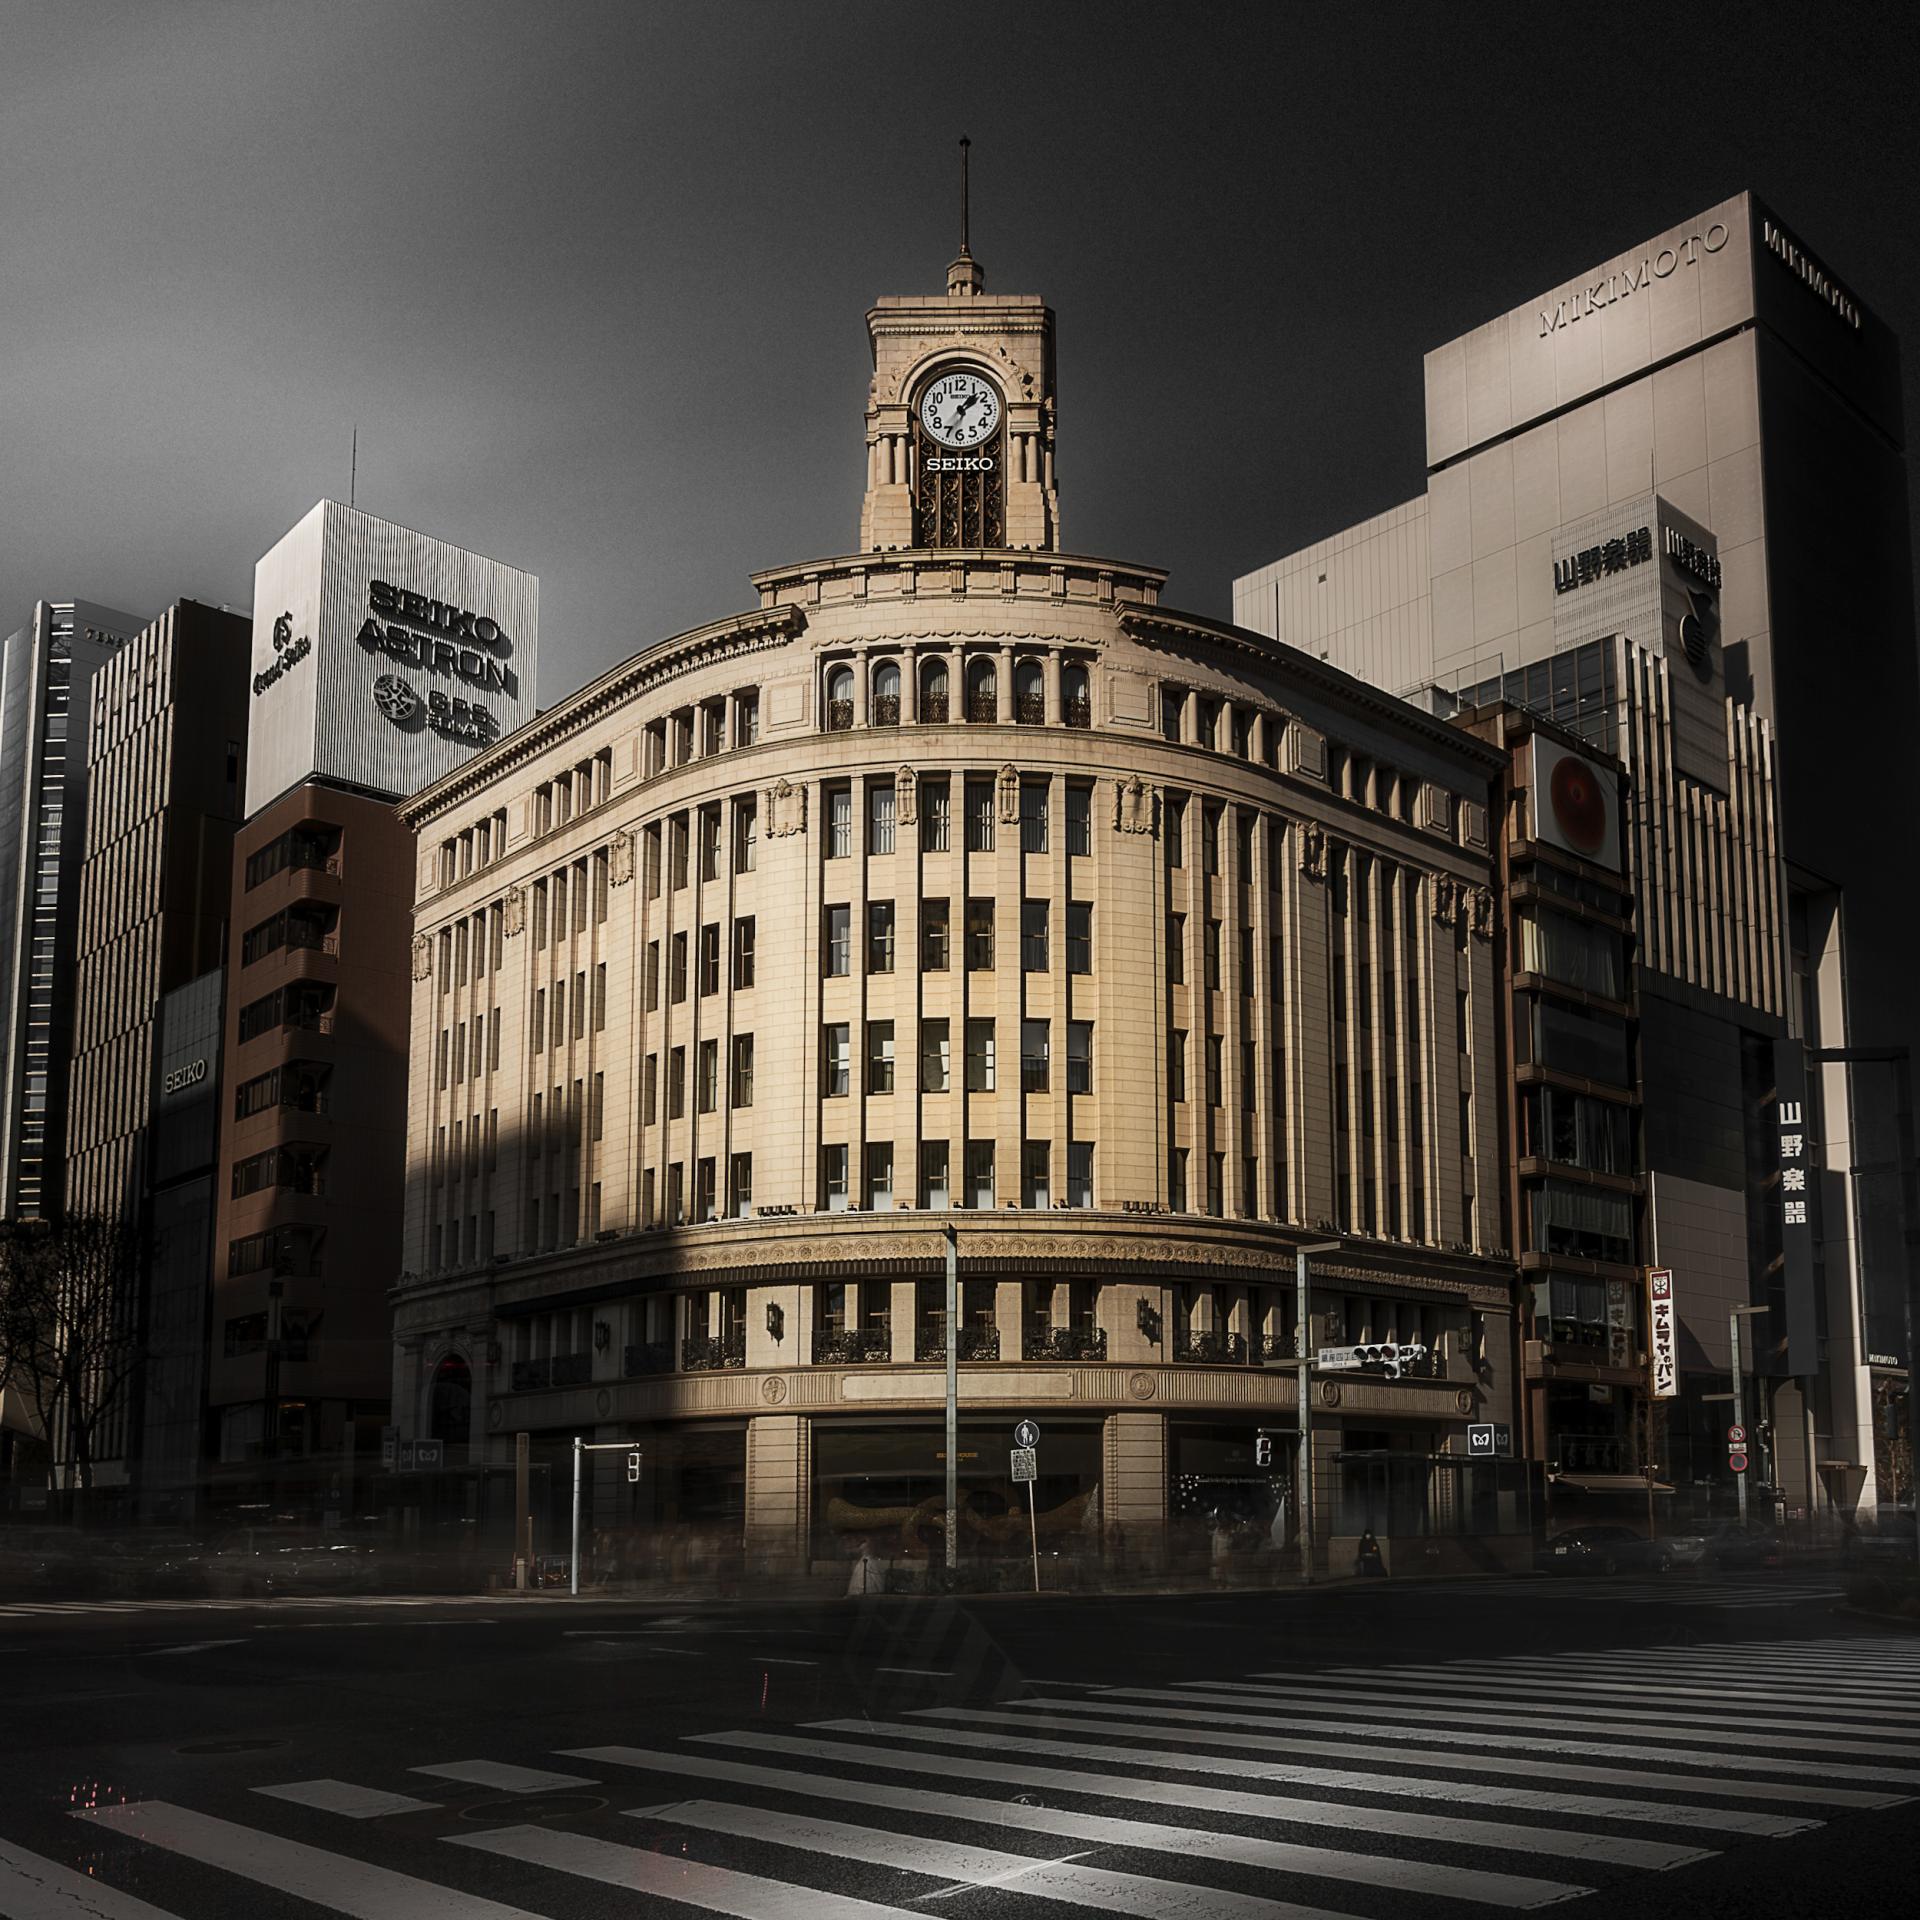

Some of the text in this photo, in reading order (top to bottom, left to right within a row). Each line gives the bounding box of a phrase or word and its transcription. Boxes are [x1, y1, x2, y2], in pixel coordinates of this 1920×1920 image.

[1763, 218, 1861, 330] MIKIMOTO
[1540, 223, 1729, 338] MIKIMOTO
[944, 382, 952, 394] 11
[955, 379, 966, 391] 12
[972, 382, 975, 394] 1
[933, 392, 943, 404] 10
[979, 391, 988, 403] 2
[928, 405, 937, 416] 9
[984, 404, 992, 416] 3
[933, 417, 942, 429] 8
[978, 417, 988, 429] 4
[944, 426, 953, 438] 7
[955, 429, 964, 441] 6
[968, 426, 977, 438] 5
[927, 457, 993, 471] SEIKO
[1554, 526, 1652, 595] 山野楽器
[370, 579, 500, 643] SEIKO
[356, 618, 507, 688] ASTRON
[428, 690, 488, 724] GPS
[165, 1059, 206, 1094] SEIKO
[1779, 1102, 1807, 1225] 山野楽器
[1655, 1304, 1673, 1390] キムラヤのパン
